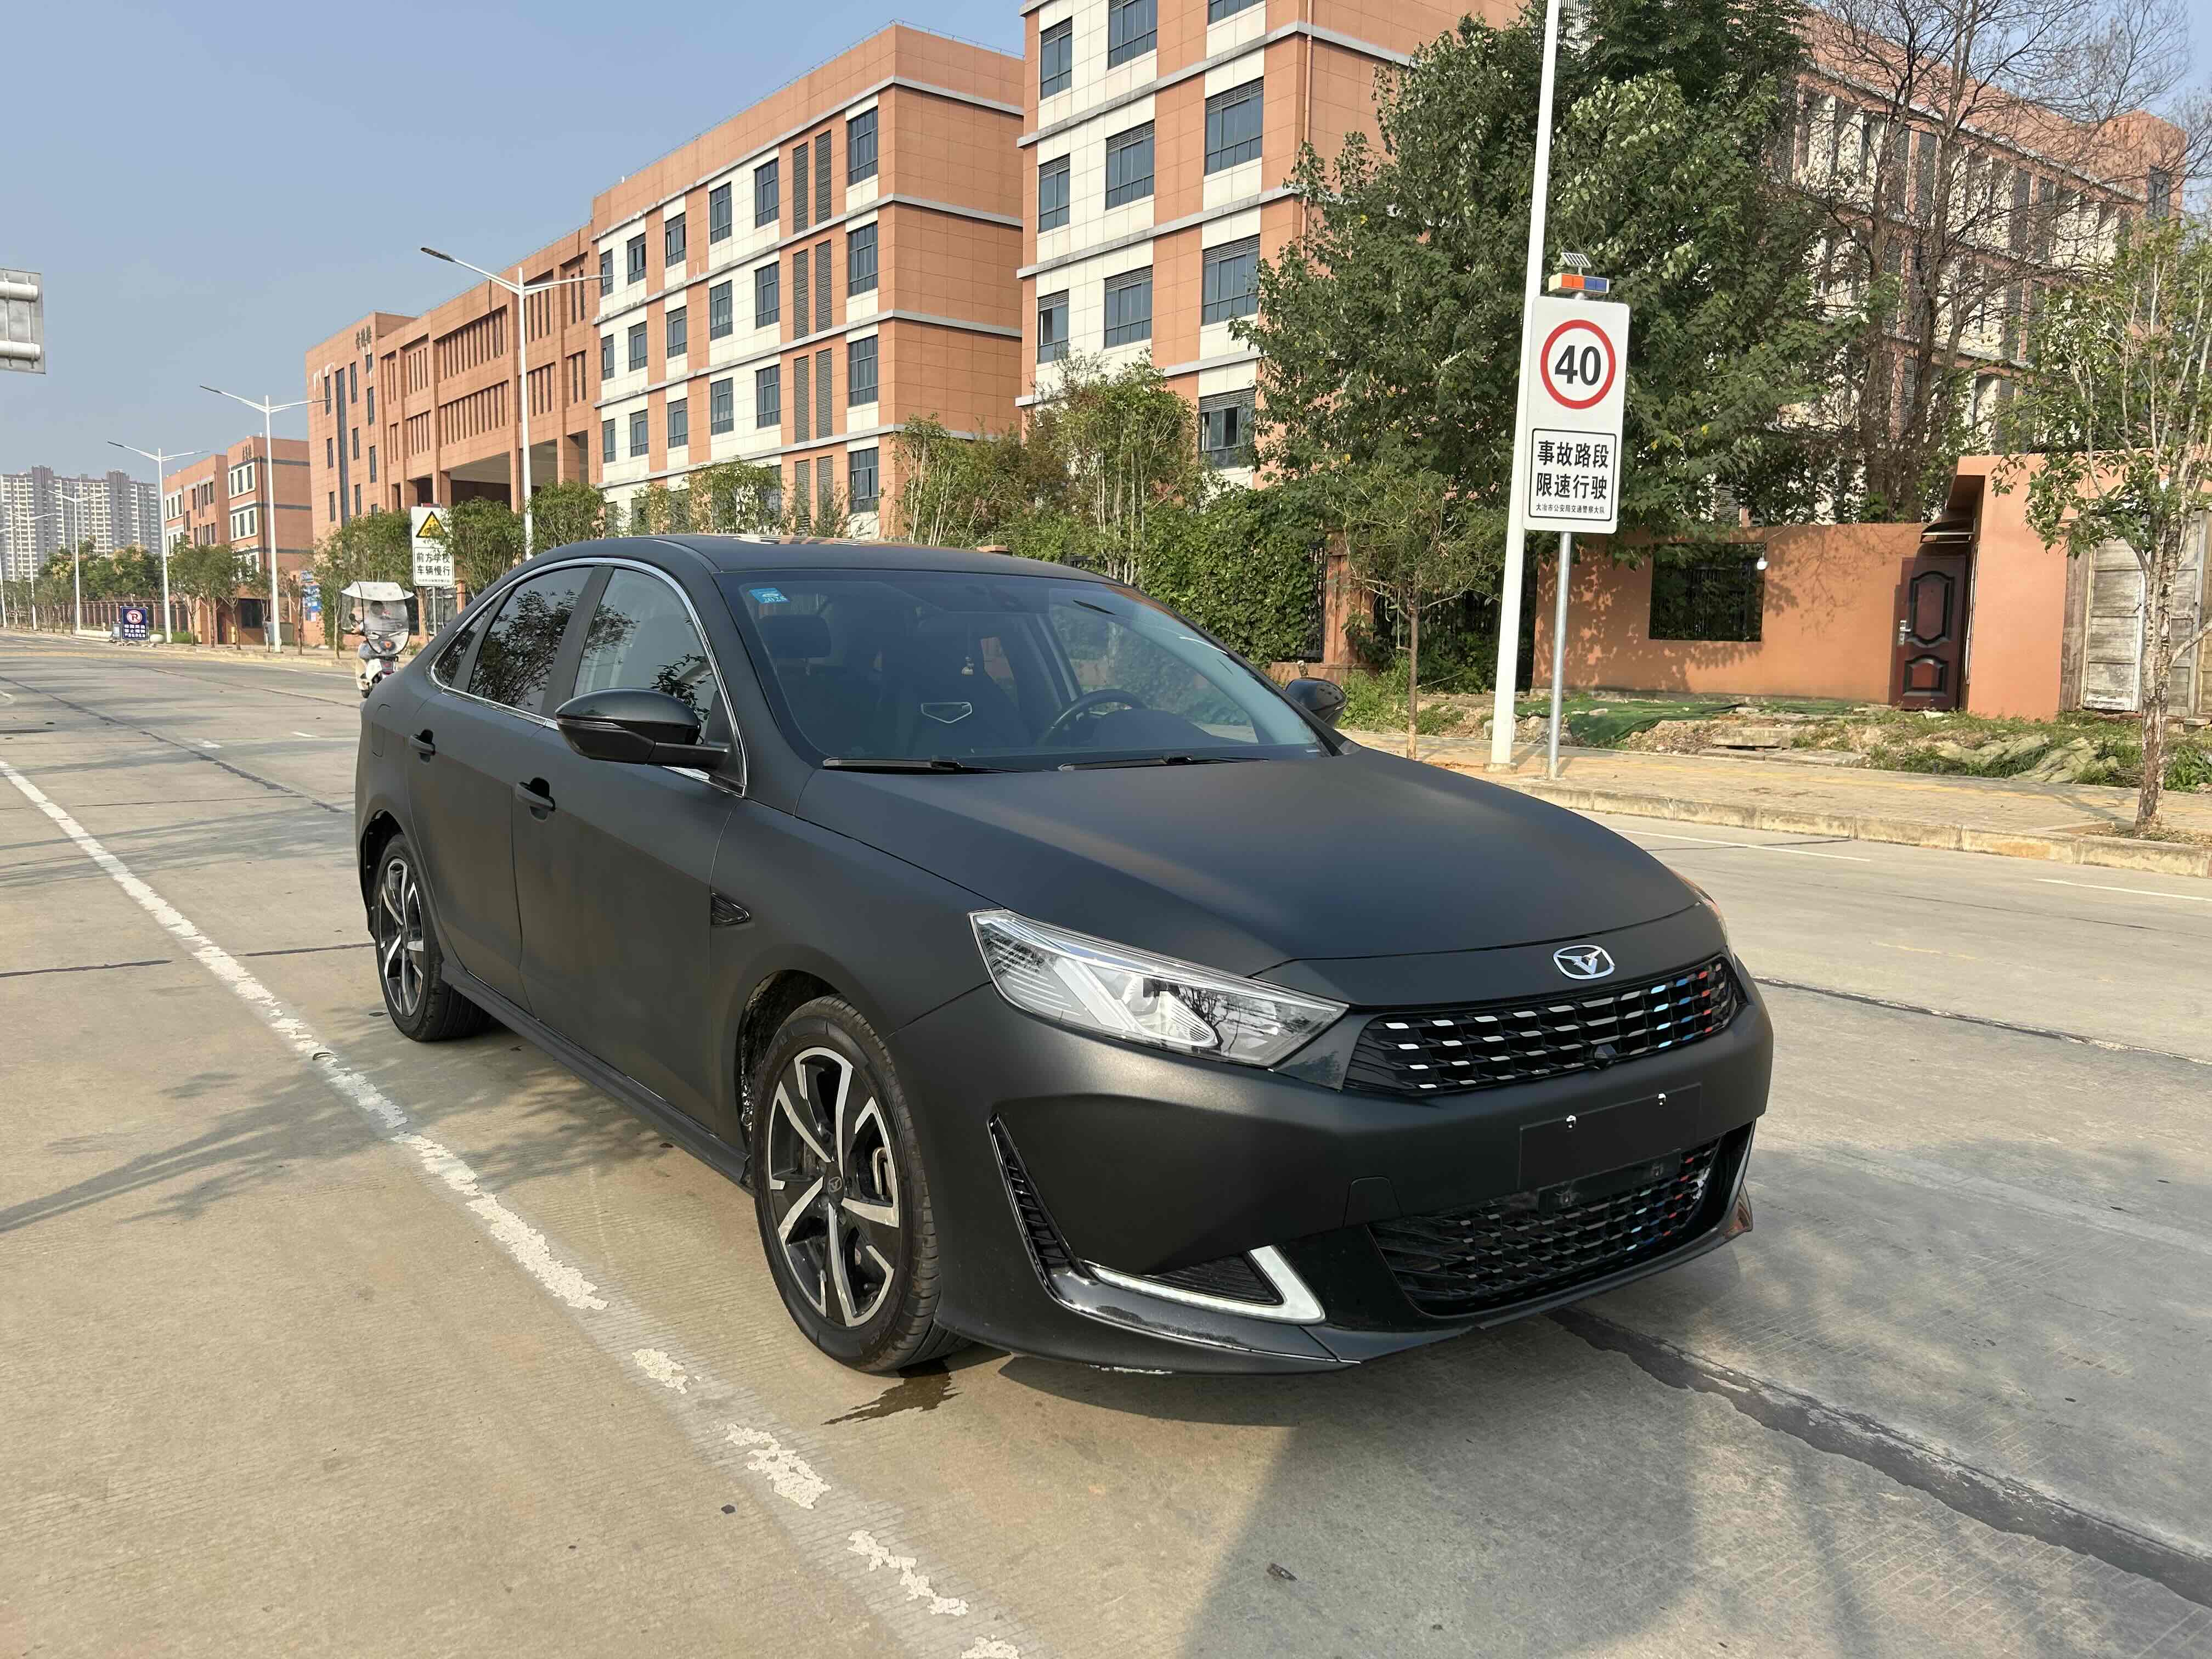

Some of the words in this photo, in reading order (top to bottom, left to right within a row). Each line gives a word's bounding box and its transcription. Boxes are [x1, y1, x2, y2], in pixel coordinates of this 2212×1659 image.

[1555, 345, 1601, 386] 40
[1538, 440, 1609, 469] 事故路段
[1536, 472, 1607, 500] 限速行驶
[1536, 504, 1605, 514] 大冶市公安局交通警察大队
[417, 565, 450, 575] 车辆慢行
